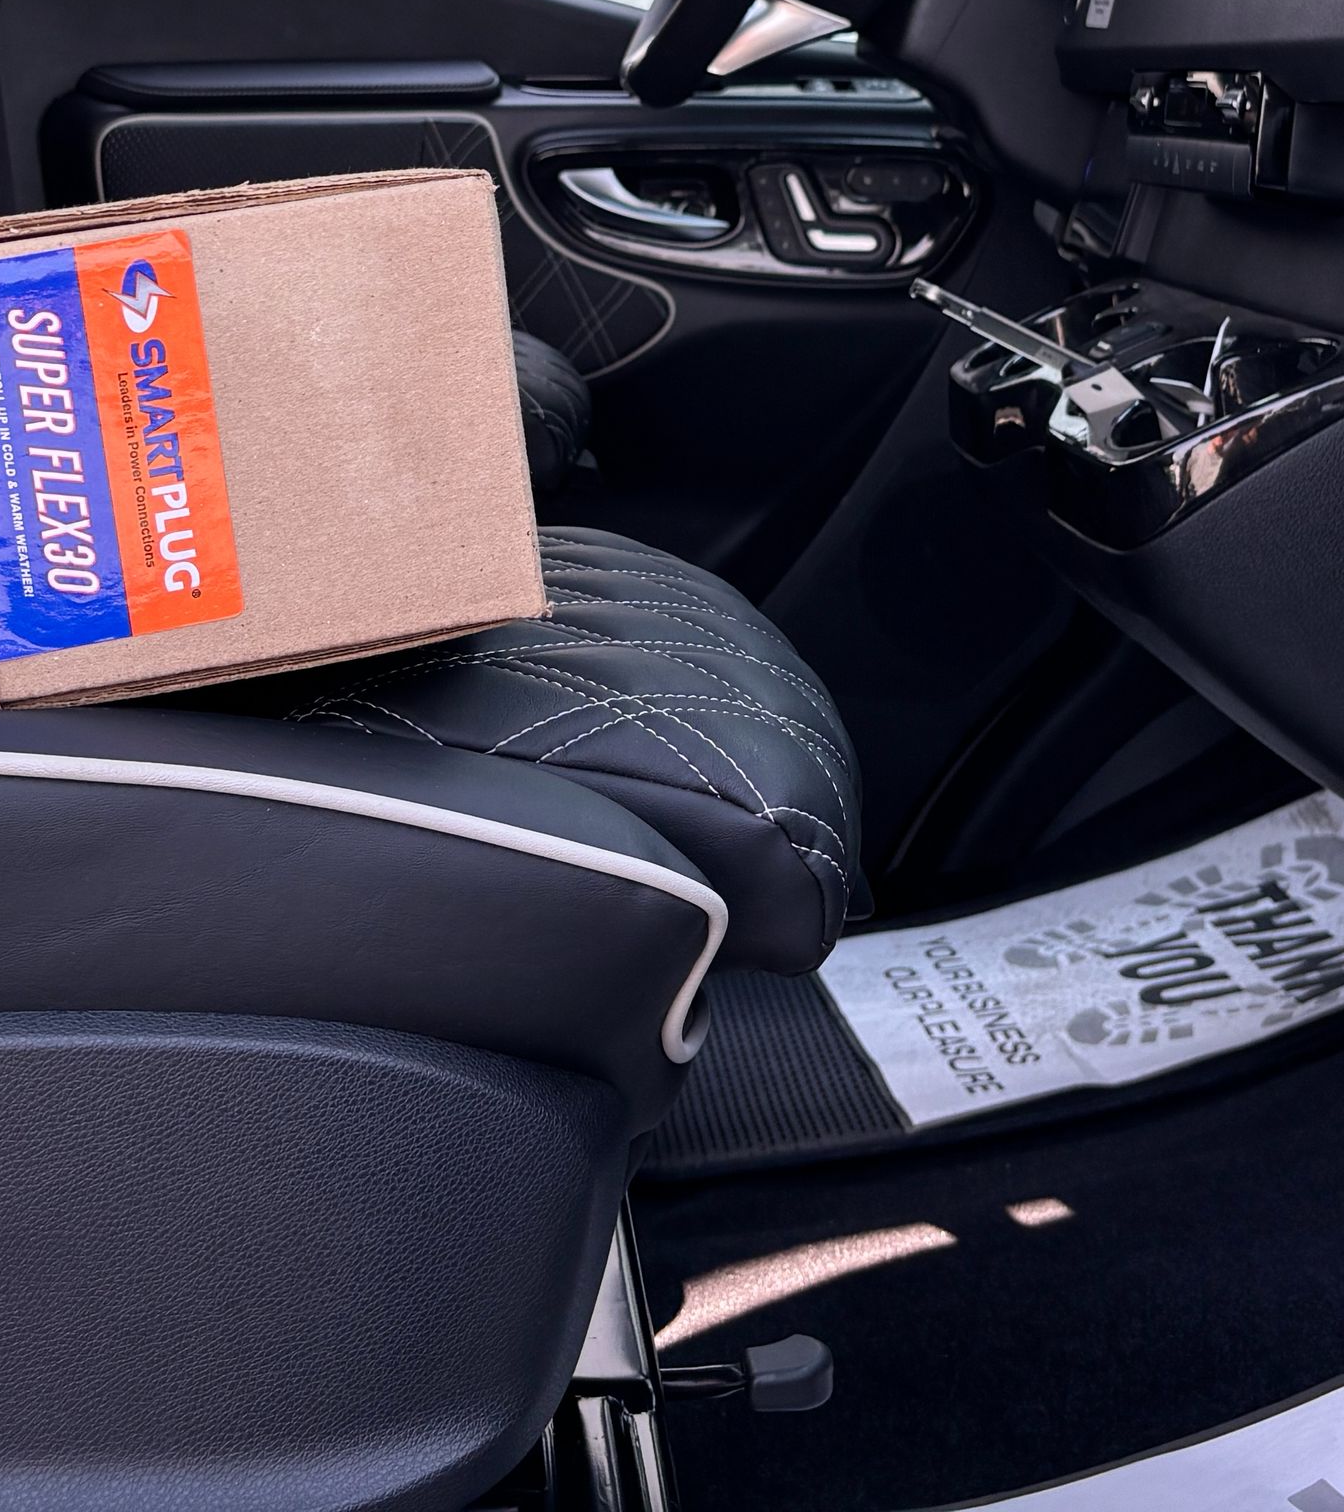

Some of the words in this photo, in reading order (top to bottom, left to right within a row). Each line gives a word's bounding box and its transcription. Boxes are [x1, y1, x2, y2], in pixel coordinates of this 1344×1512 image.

[8, 309, 75, 434] SUPER
[118, 372, 133, 424] Leaders
[0, 428, 11, 440] IN
[126, 425, 138, 439] in
[2, 444, 16, 476] COLD
[8, 481, 18, 489] &
[128, 441, 142, 482] Power
[130, 339, 200, 592] SMARTPLUG
[9, 493, 24, 530] WARM
[29, 447, 100, 599] FLEX30
[135, 486, 155, 568] Connections
[16, 534, 34, 597] WEATHER!
[918, 936, 974, 982] YOUR
[1102, 928, 1243, 1005] YOU
[883, 966, 933, 1002] OUR
[917, 1001, 1005, 1095] PLEASURE
